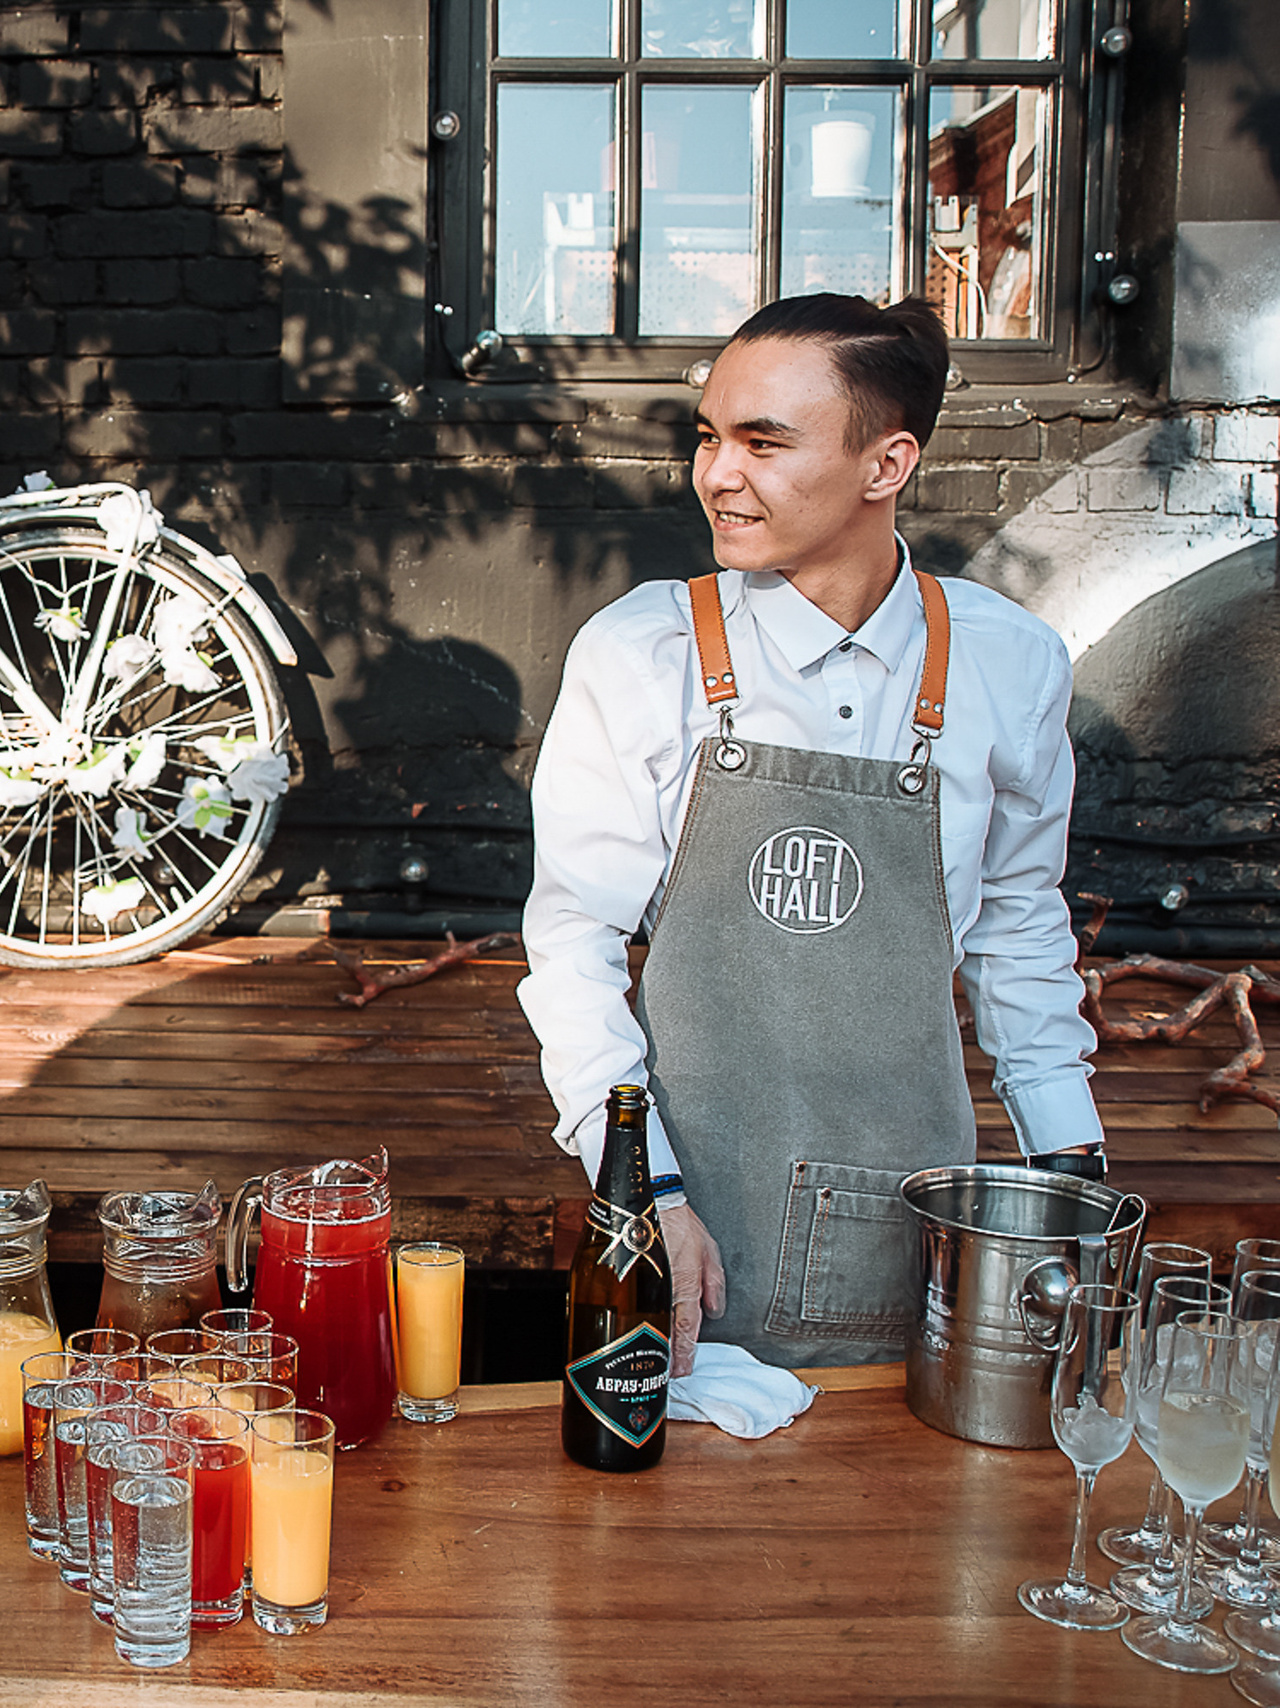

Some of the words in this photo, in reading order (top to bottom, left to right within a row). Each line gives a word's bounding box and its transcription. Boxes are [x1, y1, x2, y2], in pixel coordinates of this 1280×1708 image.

[762, 835, 844, 883] LOFT
[760, 875, 844, 924] HALL
[630, 1360, 655, 1372] 1870
